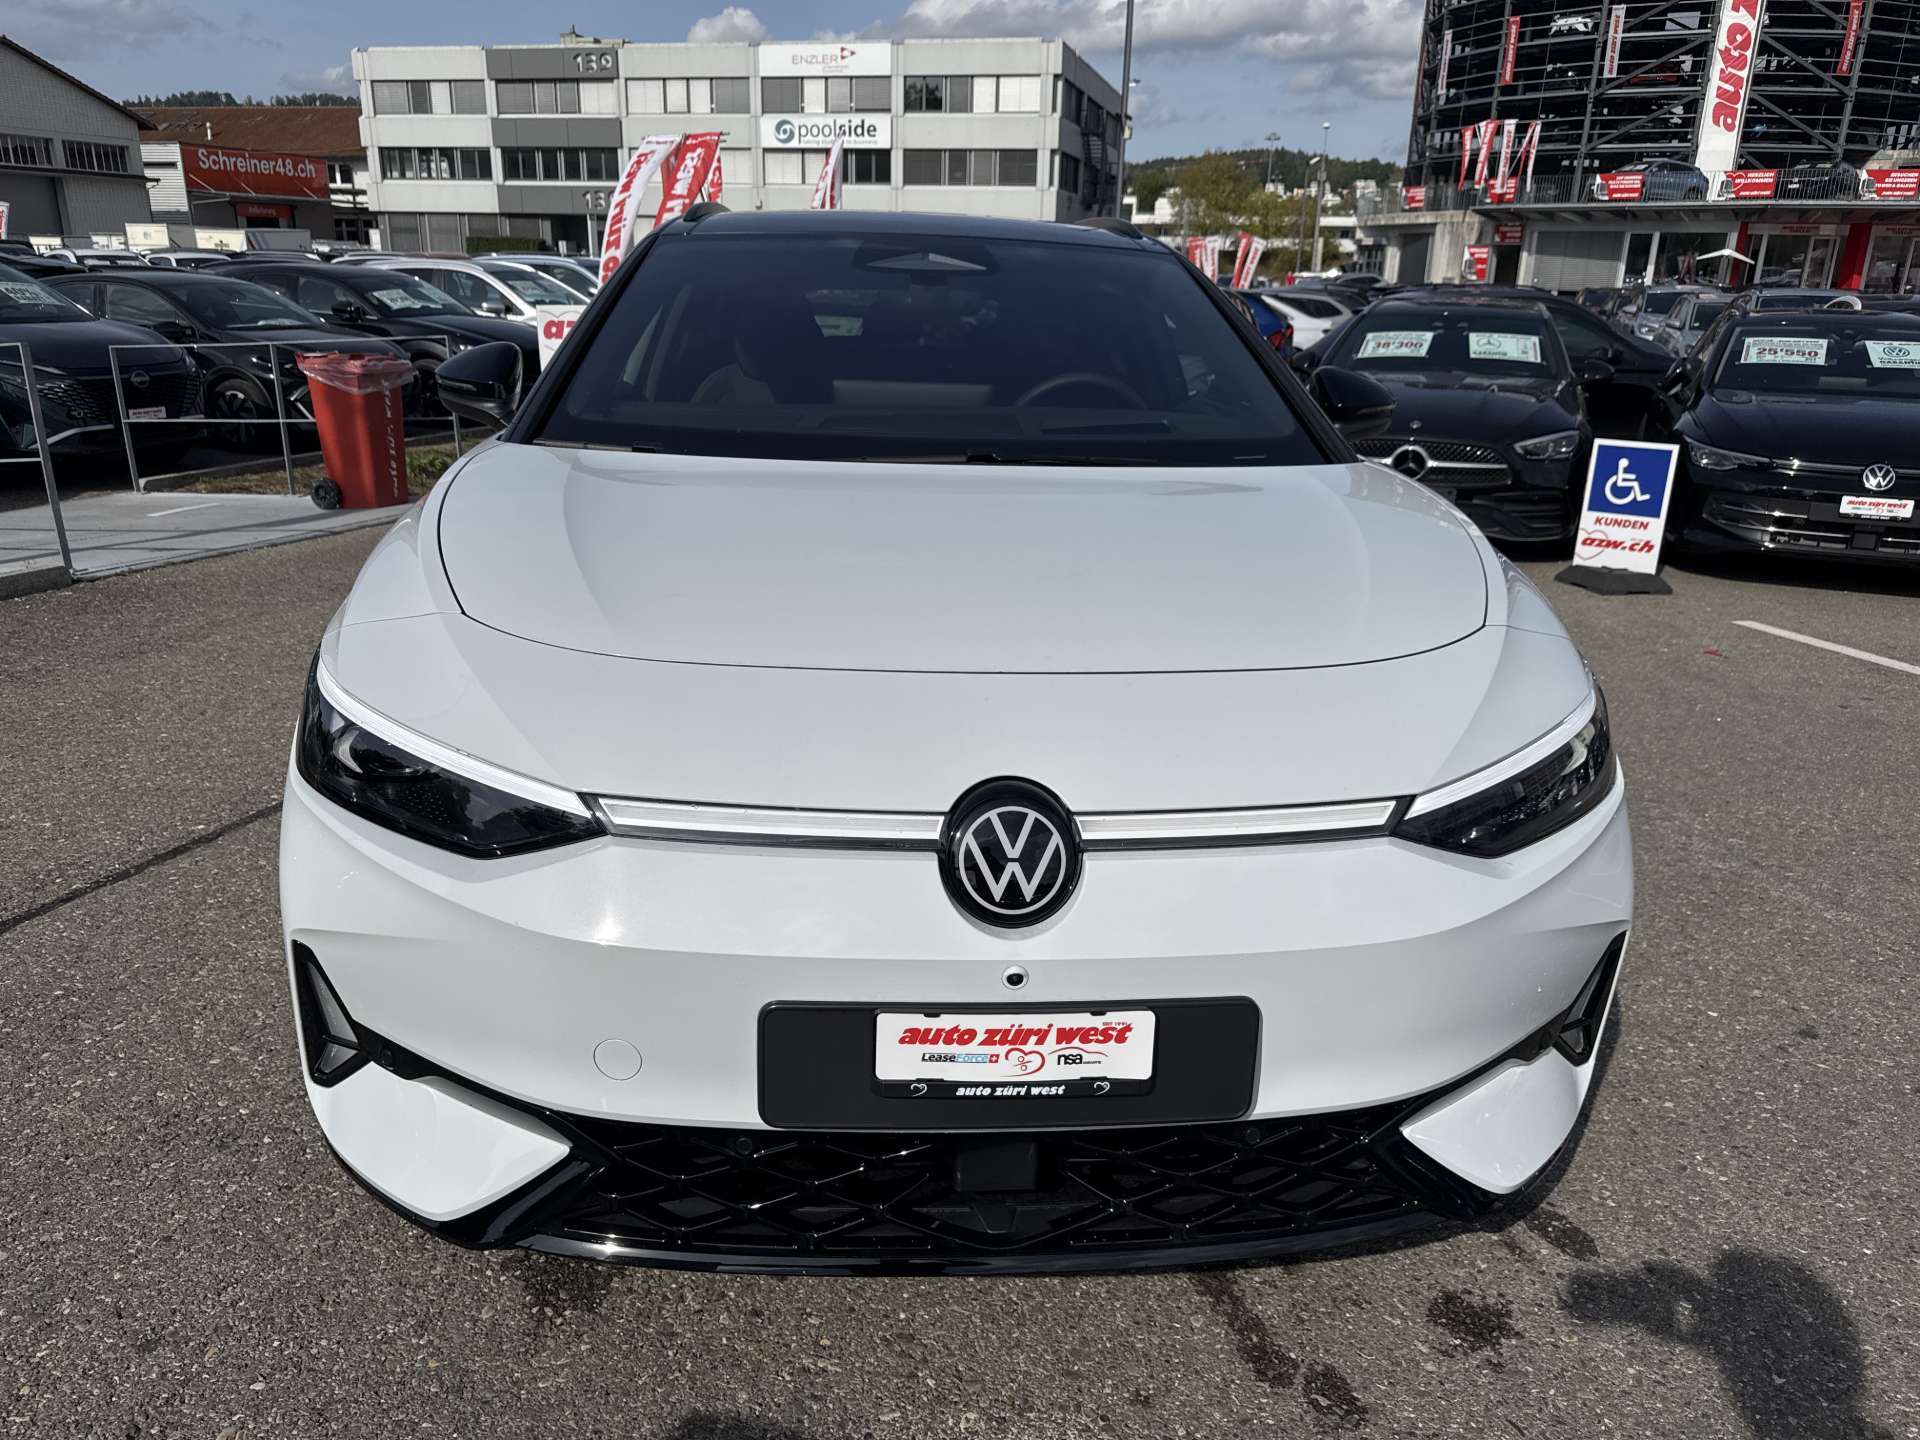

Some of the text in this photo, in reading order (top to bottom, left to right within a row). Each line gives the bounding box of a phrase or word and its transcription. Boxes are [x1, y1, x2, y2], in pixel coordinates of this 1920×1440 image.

[572, 53, 612, 73] 139
[792, 54, 839, 65] ENZLER
[1712, 22, 1752, 132] auto
[798, 119, 877, 144] poolside
[198, 148, 316, 178] Schreiner48.ch
[1756, 347, 1819, 357] 25'550
[1594, 516, 1649, 530] KUNDEN
[1581, 537, 1655, 553] azw.ch
[898, 1023, 1134, 1046] auto züri west
[921, 1052, 989, 1063] LeaseForce
[1057, 1053, 1083, 1065] nsa
[955, 1084, 1066, 1096] auto züri west
